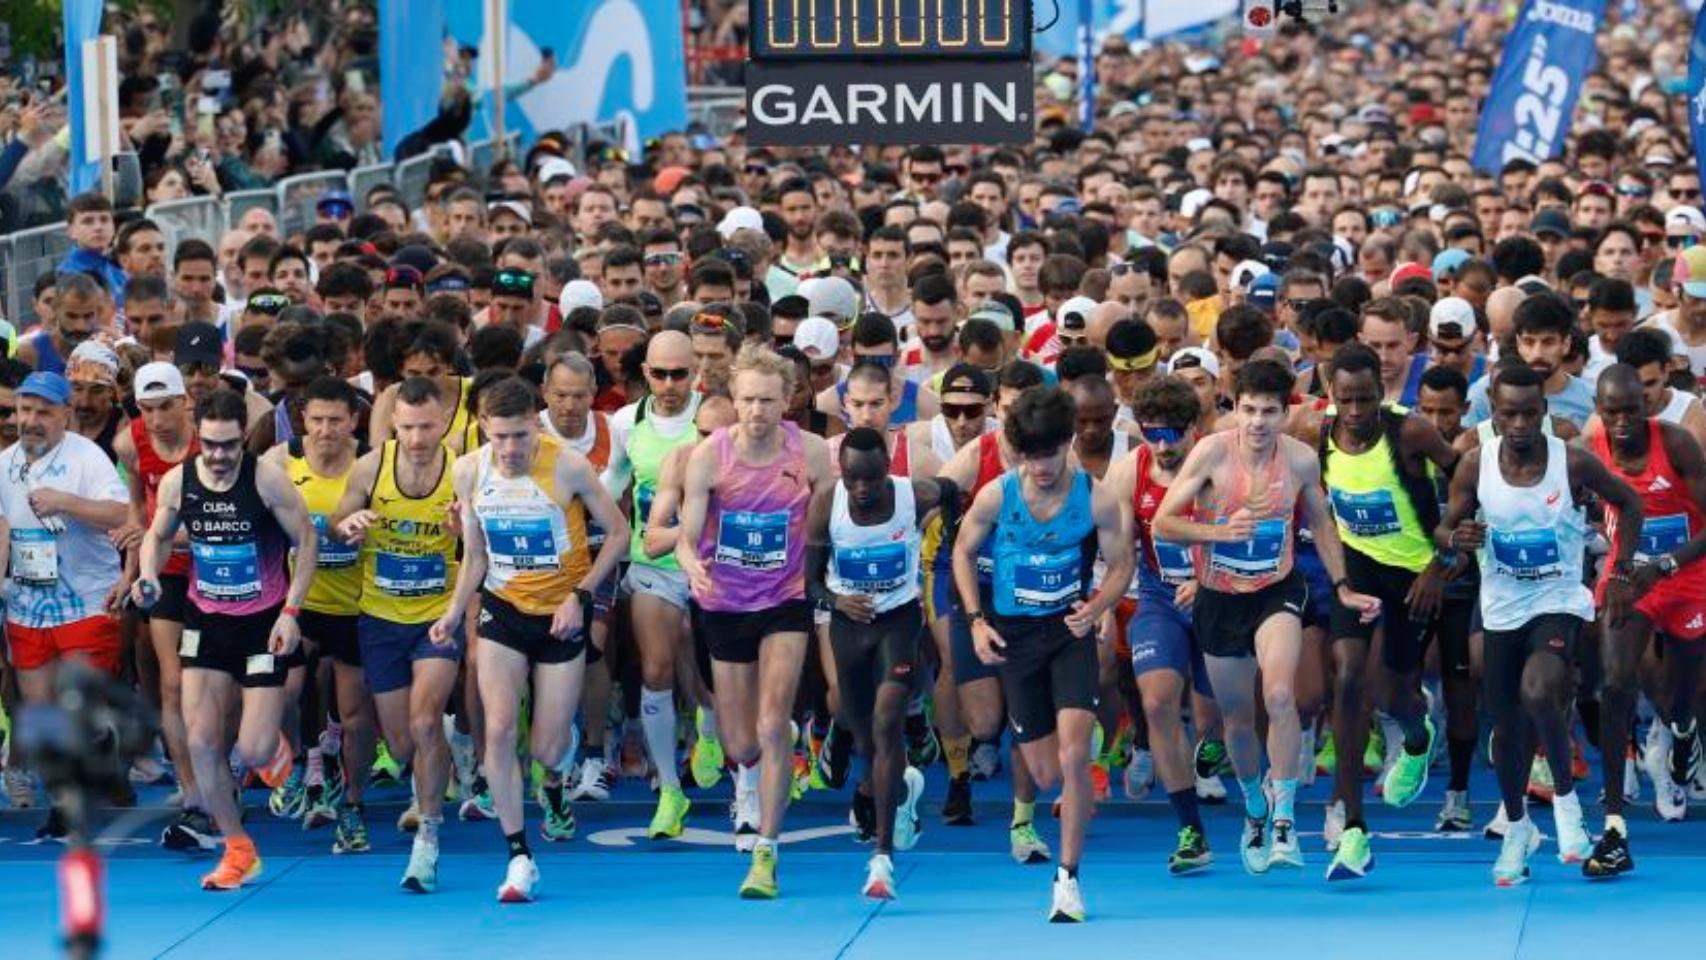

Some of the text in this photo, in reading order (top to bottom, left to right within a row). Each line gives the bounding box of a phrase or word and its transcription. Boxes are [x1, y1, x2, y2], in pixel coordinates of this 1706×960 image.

[751, 82, 1017, 124] GARMIN
[204, 521, 251, 531] BARCO
[748, 532, 762, 546] 10
[868, 563, 878, 576] 6
